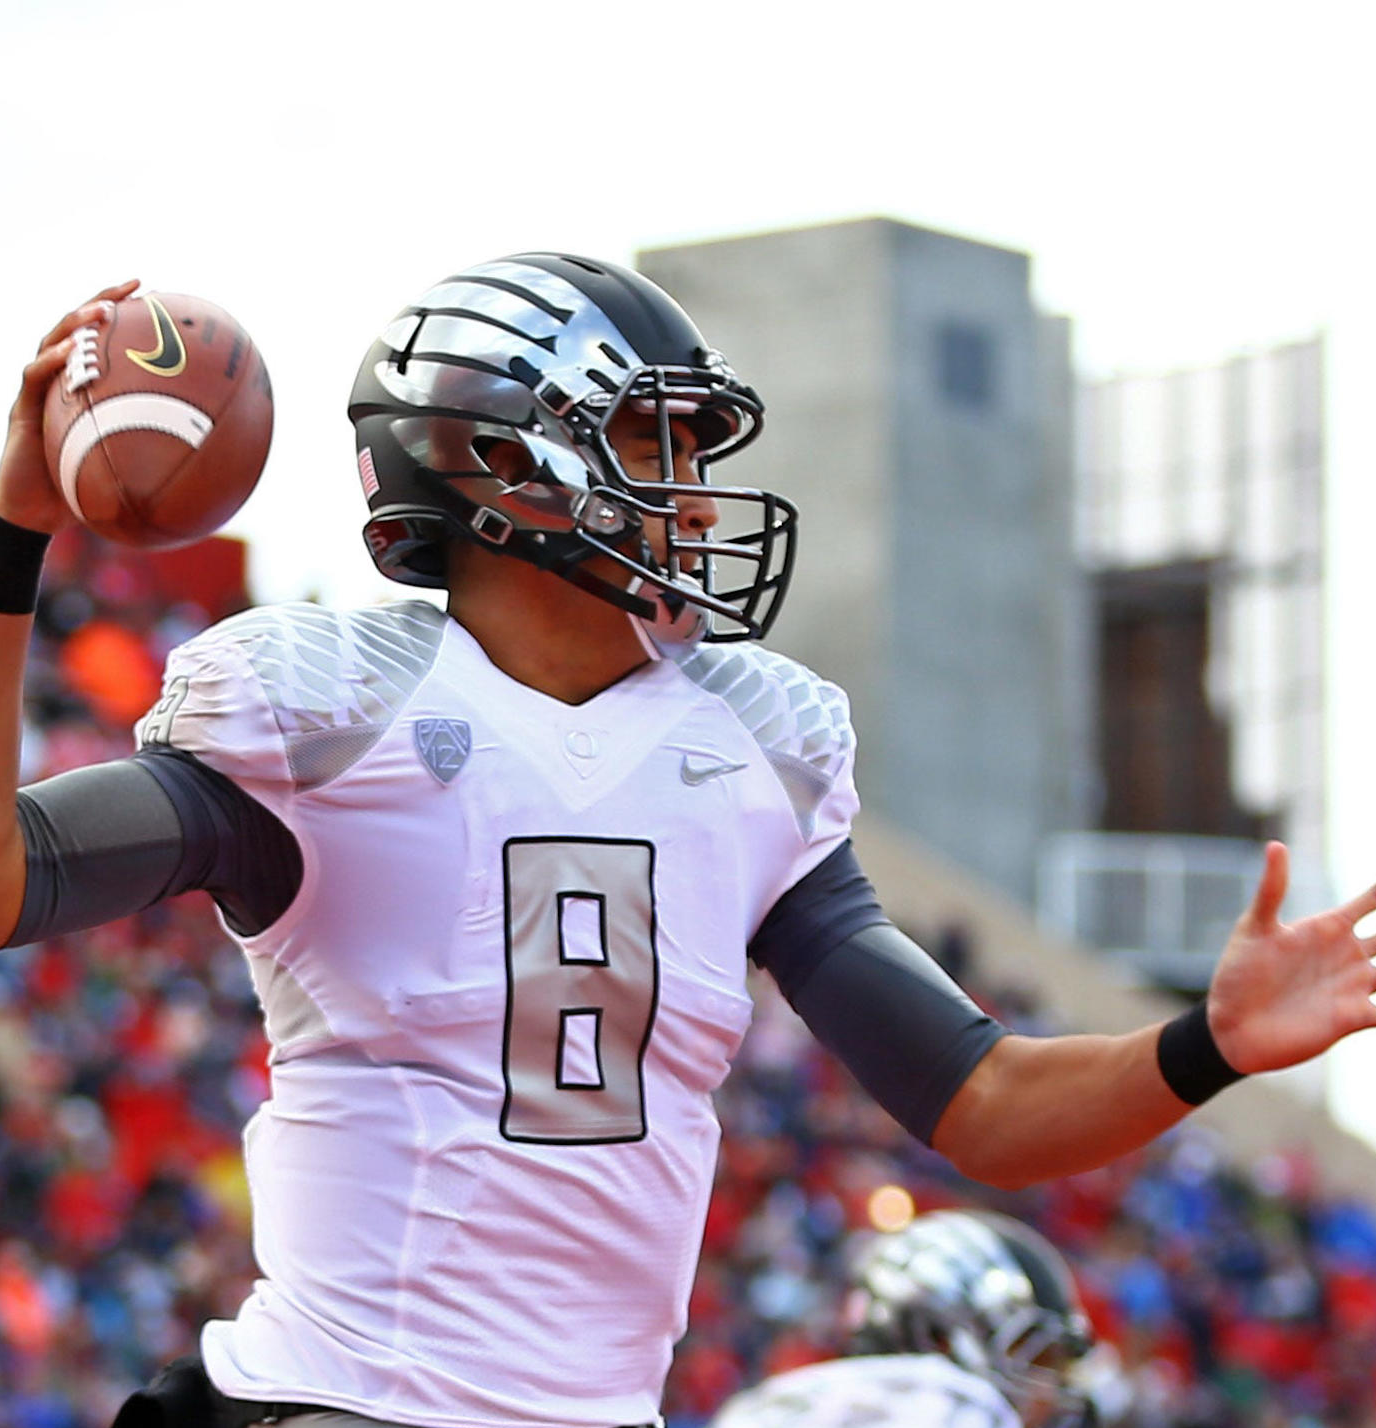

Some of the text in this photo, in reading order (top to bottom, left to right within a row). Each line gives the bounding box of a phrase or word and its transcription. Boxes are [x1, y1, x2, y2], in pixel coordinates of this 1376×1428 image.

[417, 719, 469, 756] PAC
[431, 744, 461, 769] 12
[499, 836, 660, 1146] 8
